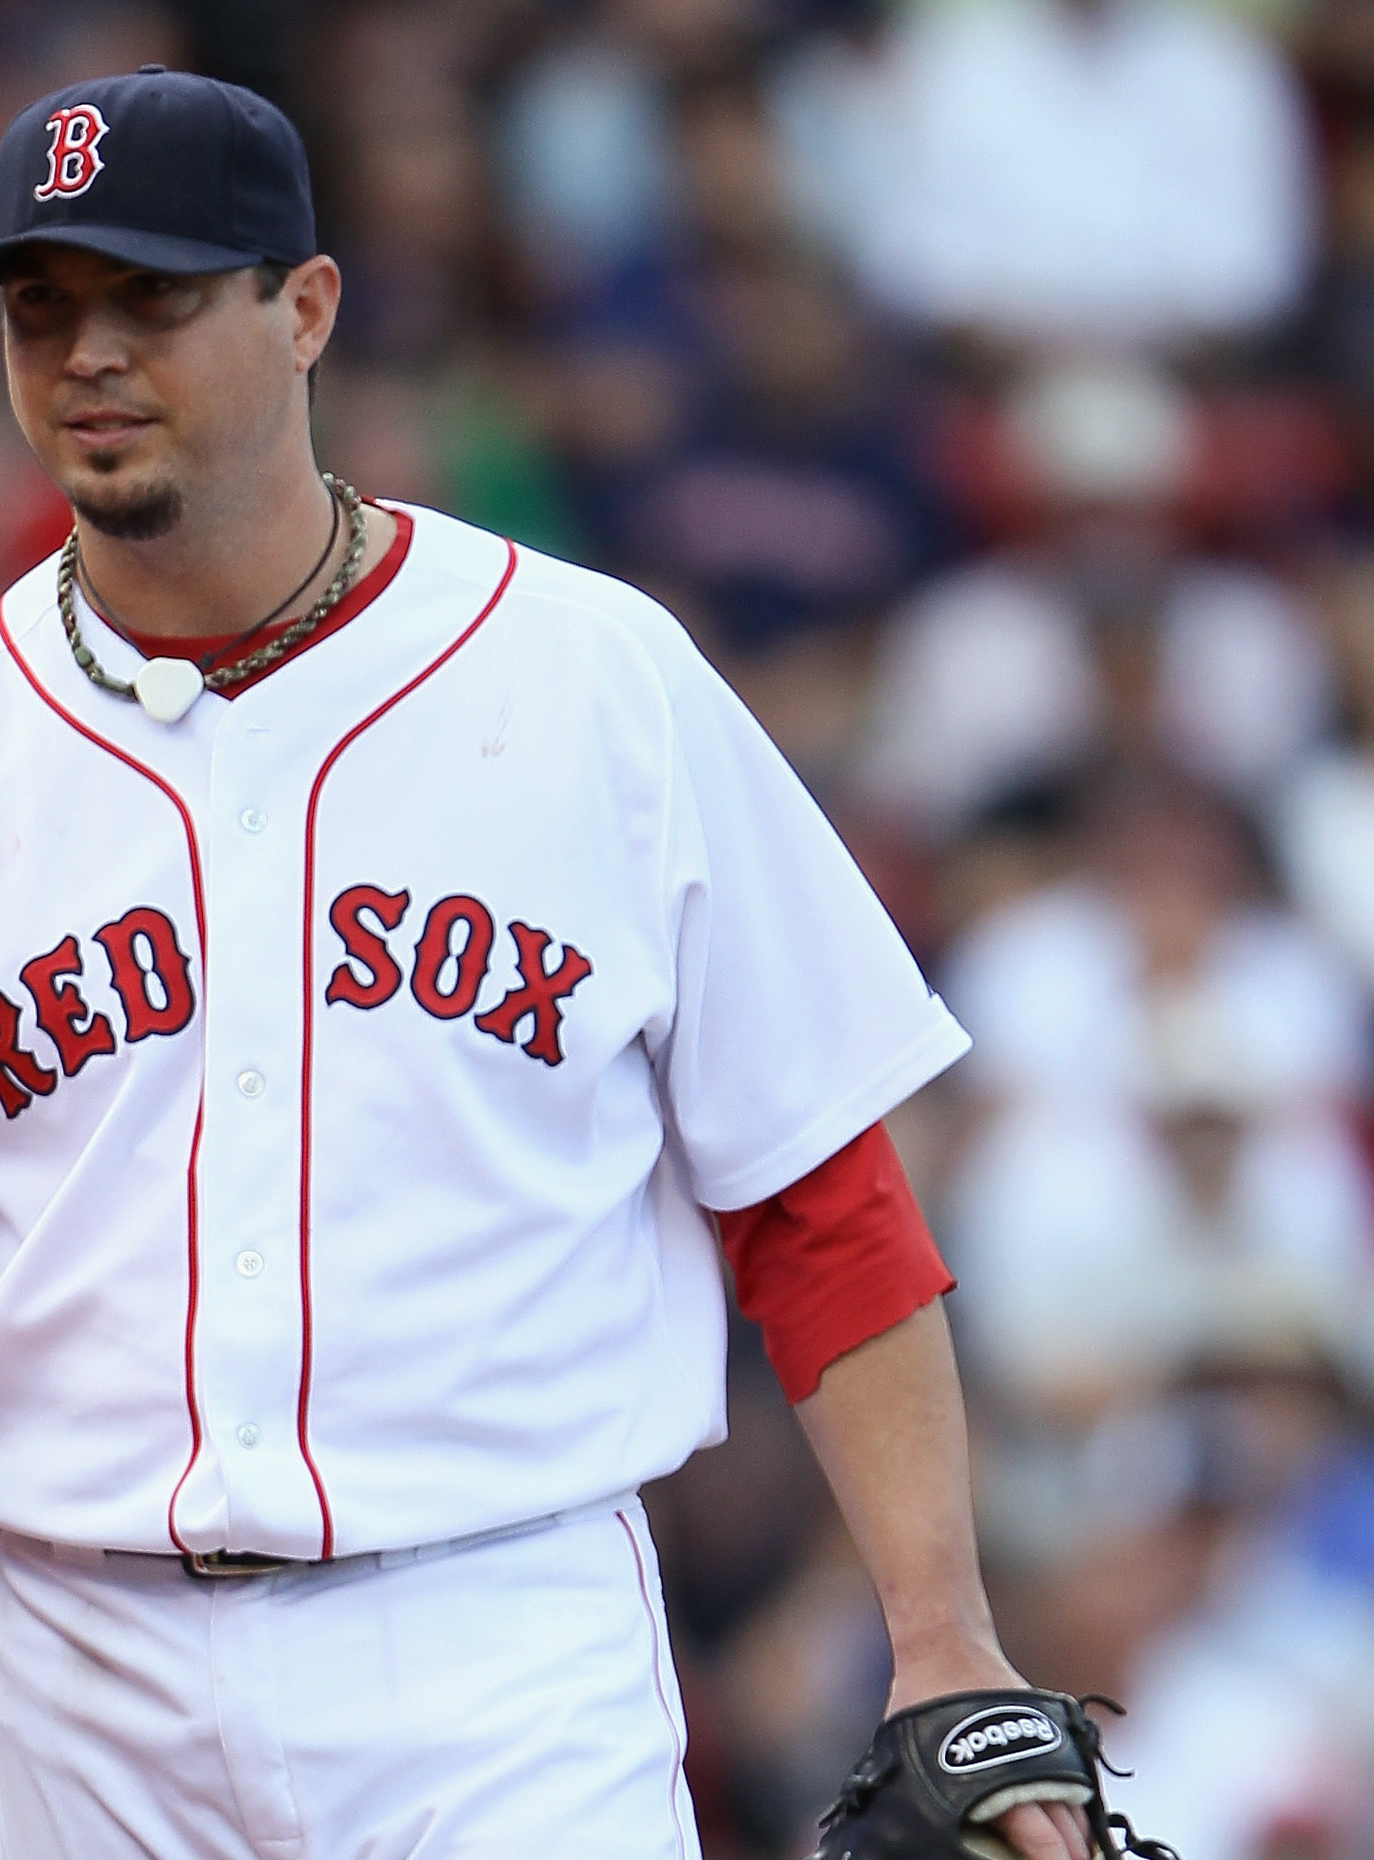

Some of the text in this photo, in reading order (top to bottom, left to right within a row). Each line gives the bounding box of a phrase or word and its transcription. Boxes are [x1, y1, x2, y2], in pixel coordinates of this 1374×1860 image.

[33, 104, 110, 202] B
[325, 883, 593, 1068] SOX
[948, 1717, 1056, 1764] Reebok
